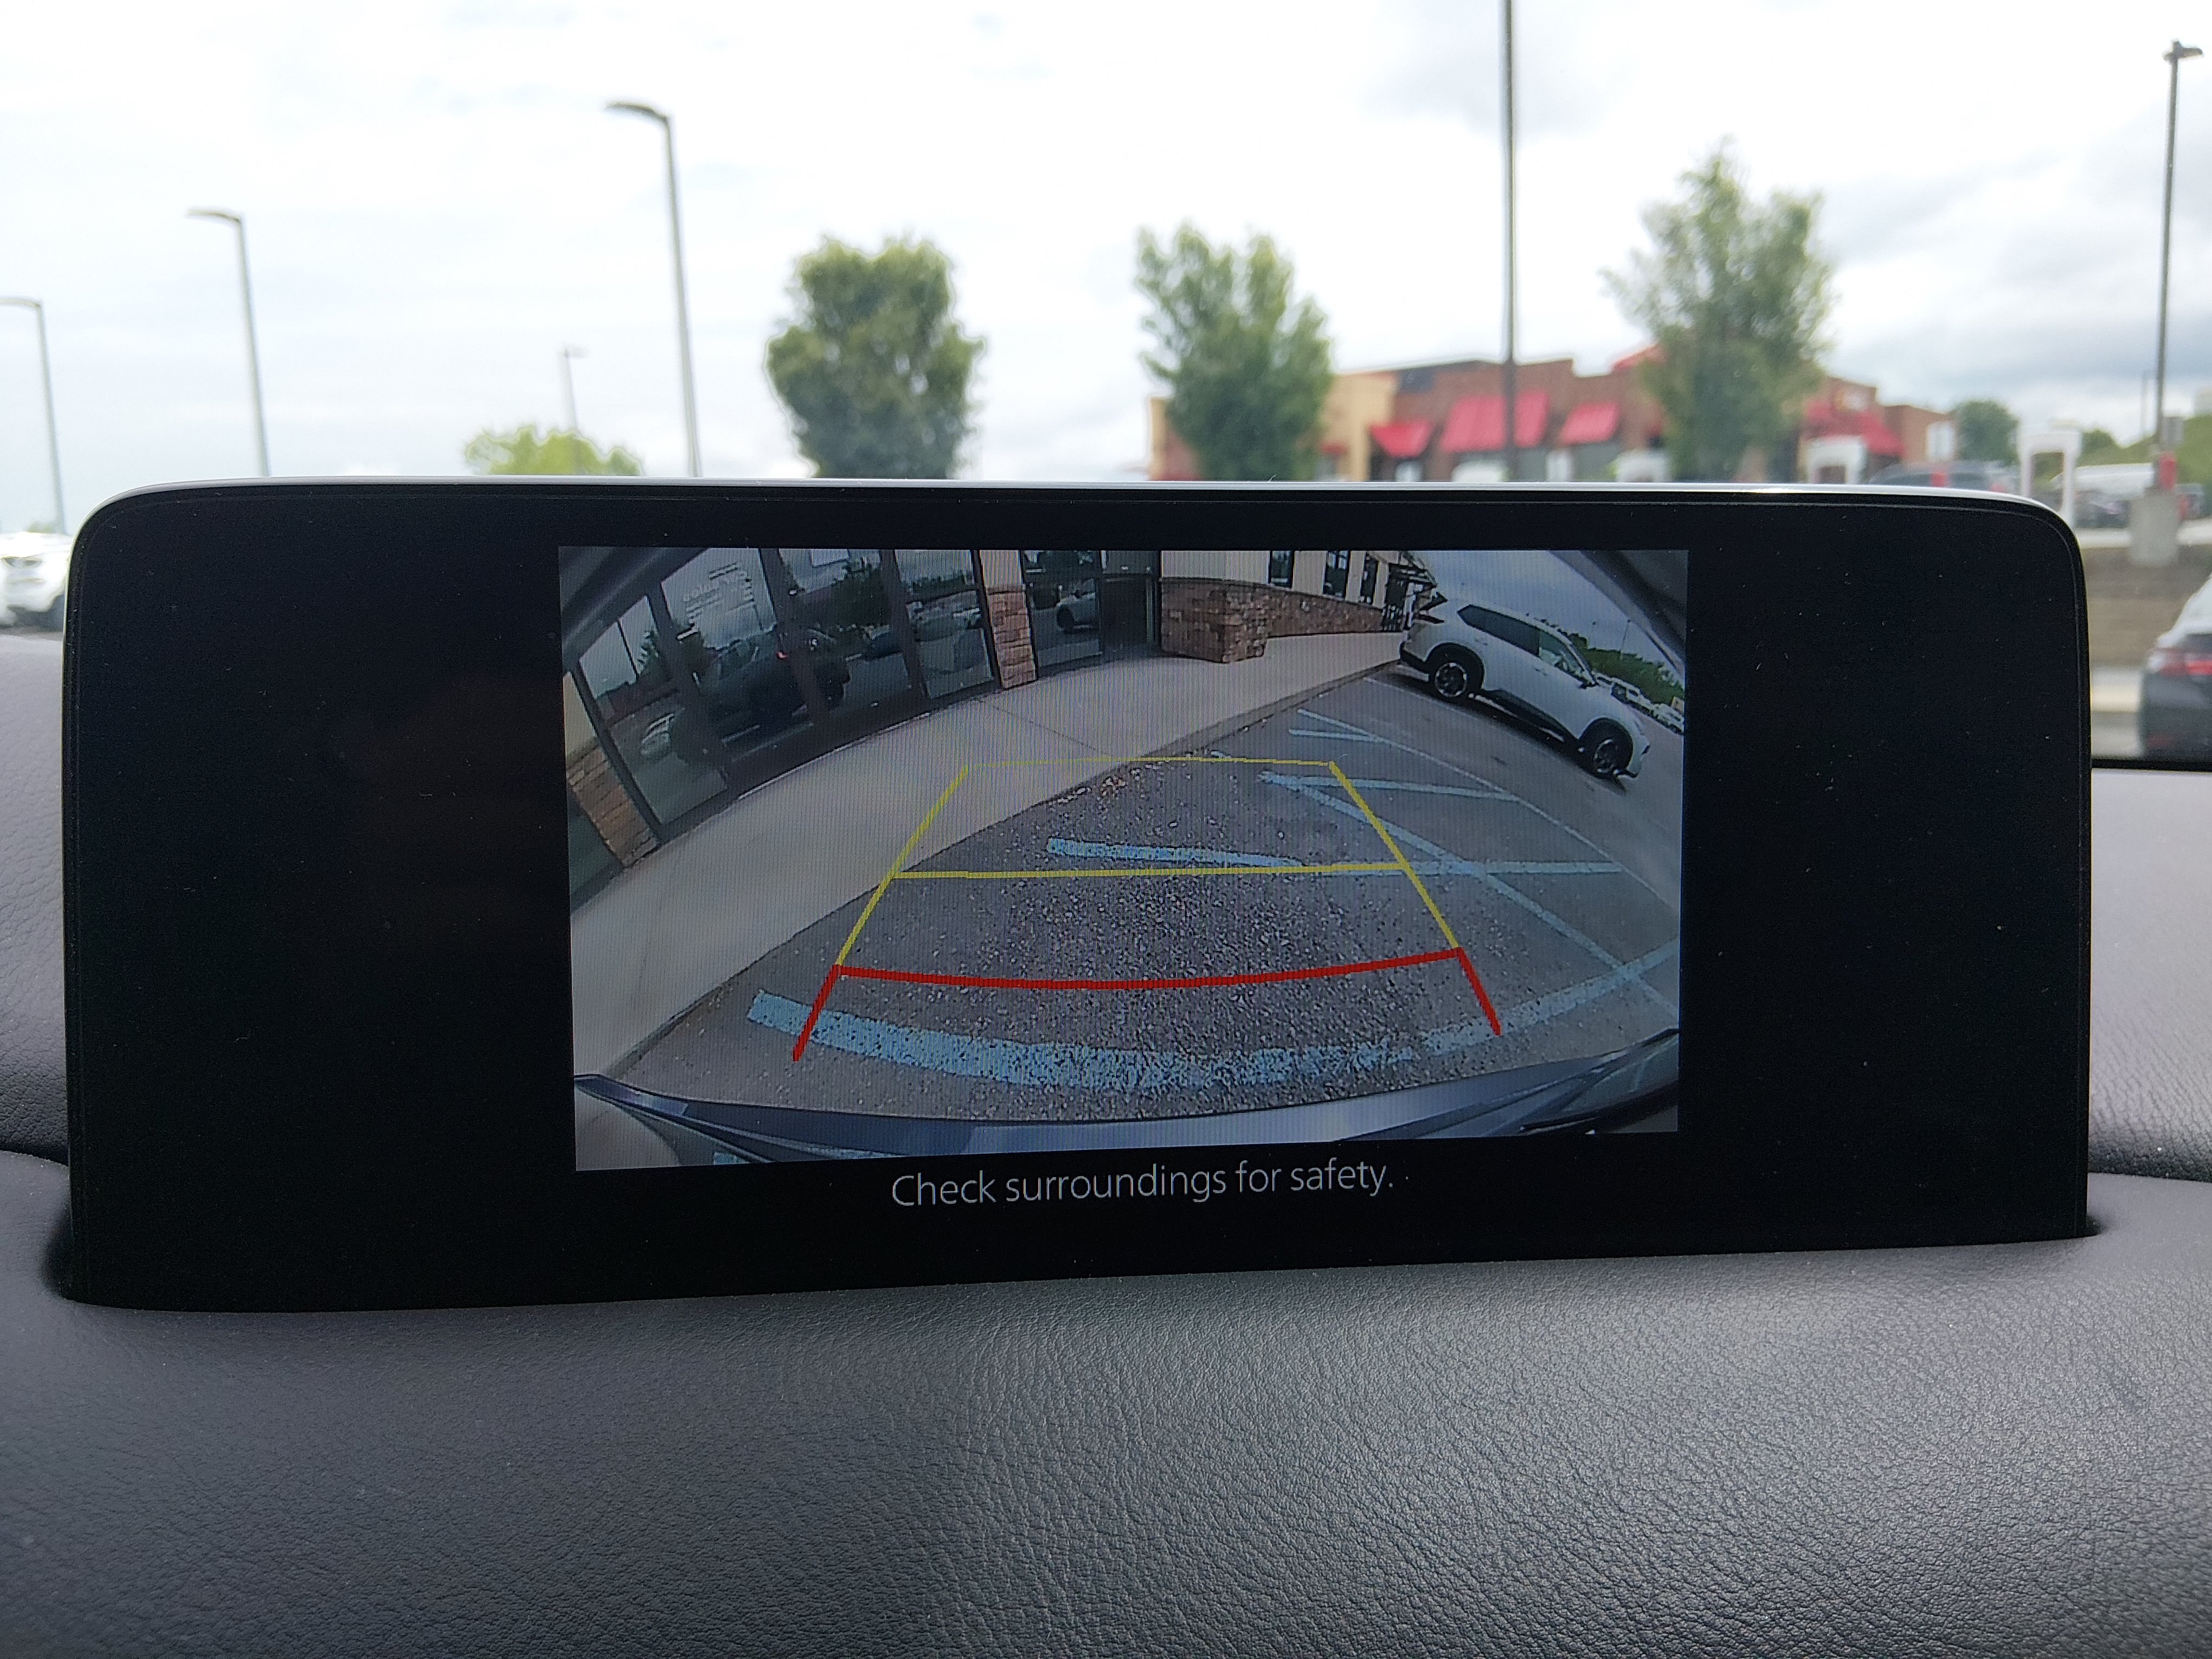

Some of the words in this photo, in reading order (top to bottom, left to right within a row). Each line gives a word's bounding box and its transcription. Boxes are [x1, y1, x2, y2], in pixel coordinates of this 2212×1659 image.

[892, 1170, 996, 1207] Check
[1006, 1163, 1227, 1204] surroundings
[1236, 1160, 1282, 1193] for
[1291, 1157, 1394, 1198] safety.
